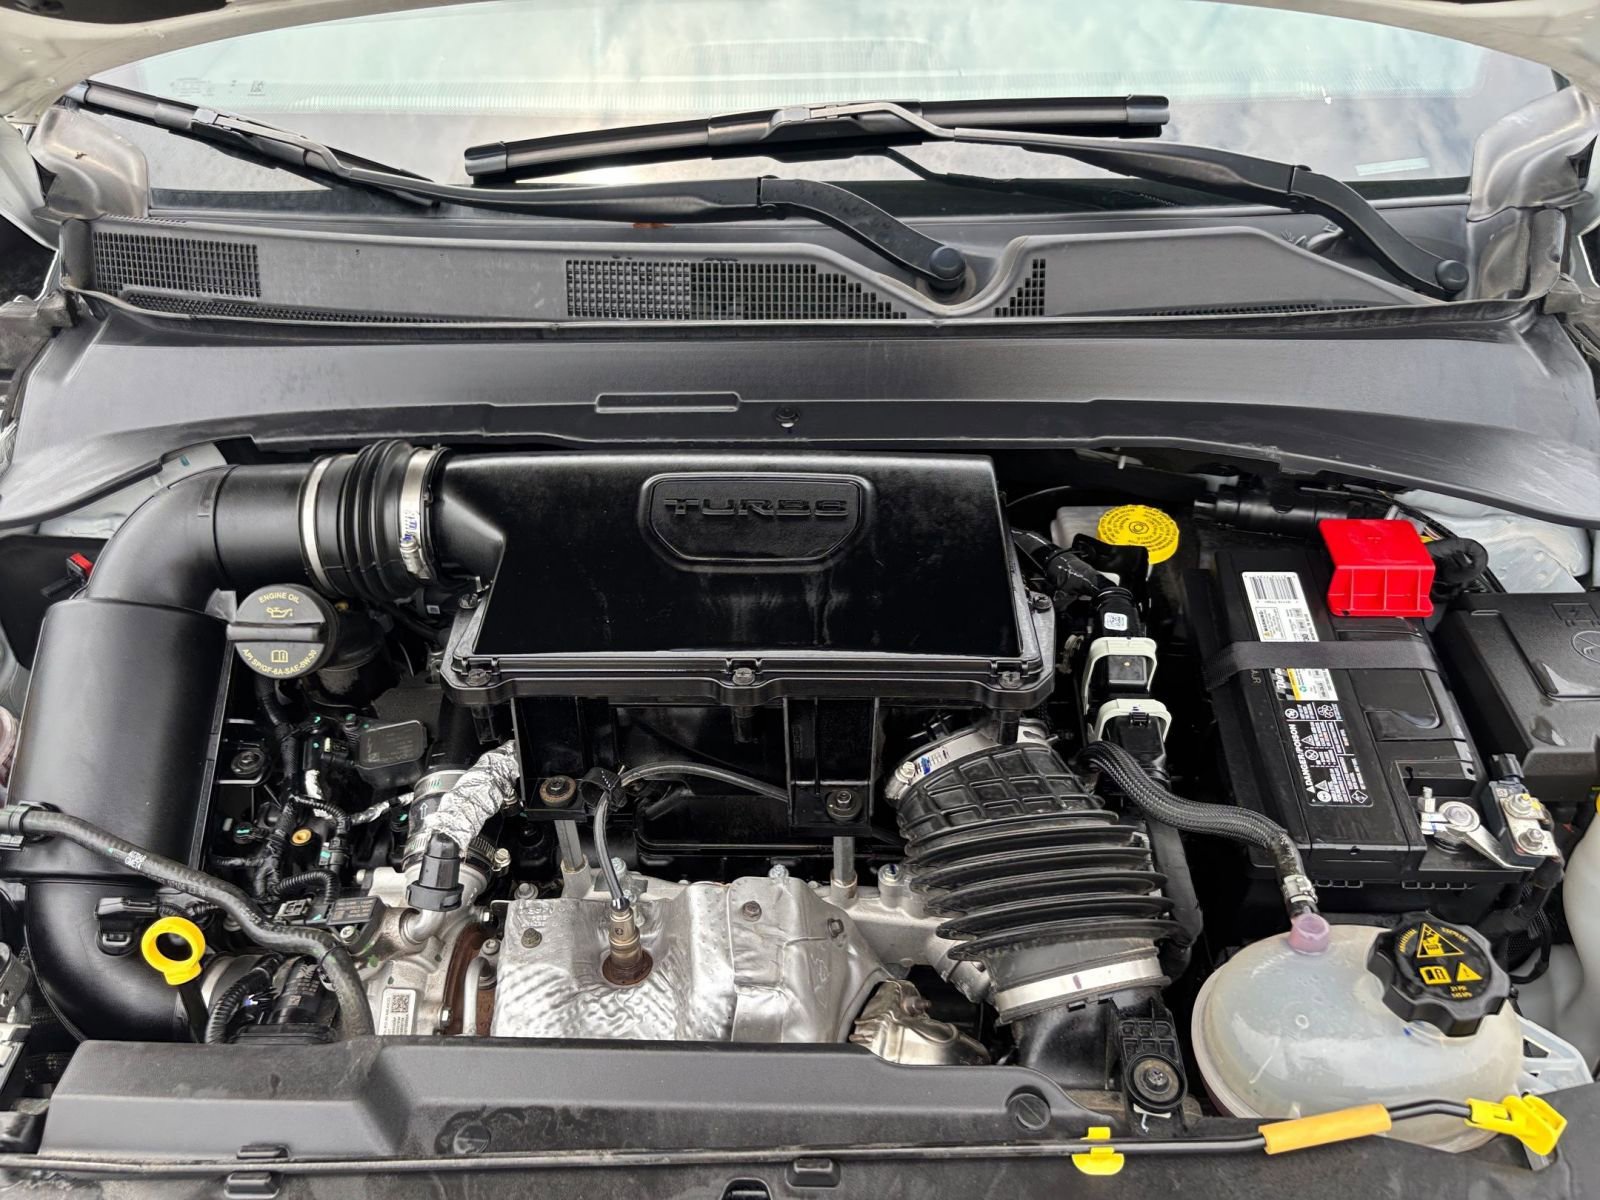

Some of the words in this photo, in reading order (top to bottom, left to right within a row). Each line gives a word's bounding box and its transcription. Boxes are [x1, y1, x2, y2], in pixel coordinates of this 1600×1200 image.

[663, 498, 849, 517] TURBO
[258, 592, 287, 603] ENGINE
[288, 594, 299, 604] OIL
[242, 649, 253, 660] API
[1288, 723, 1313, 786] DANGER/POISON
